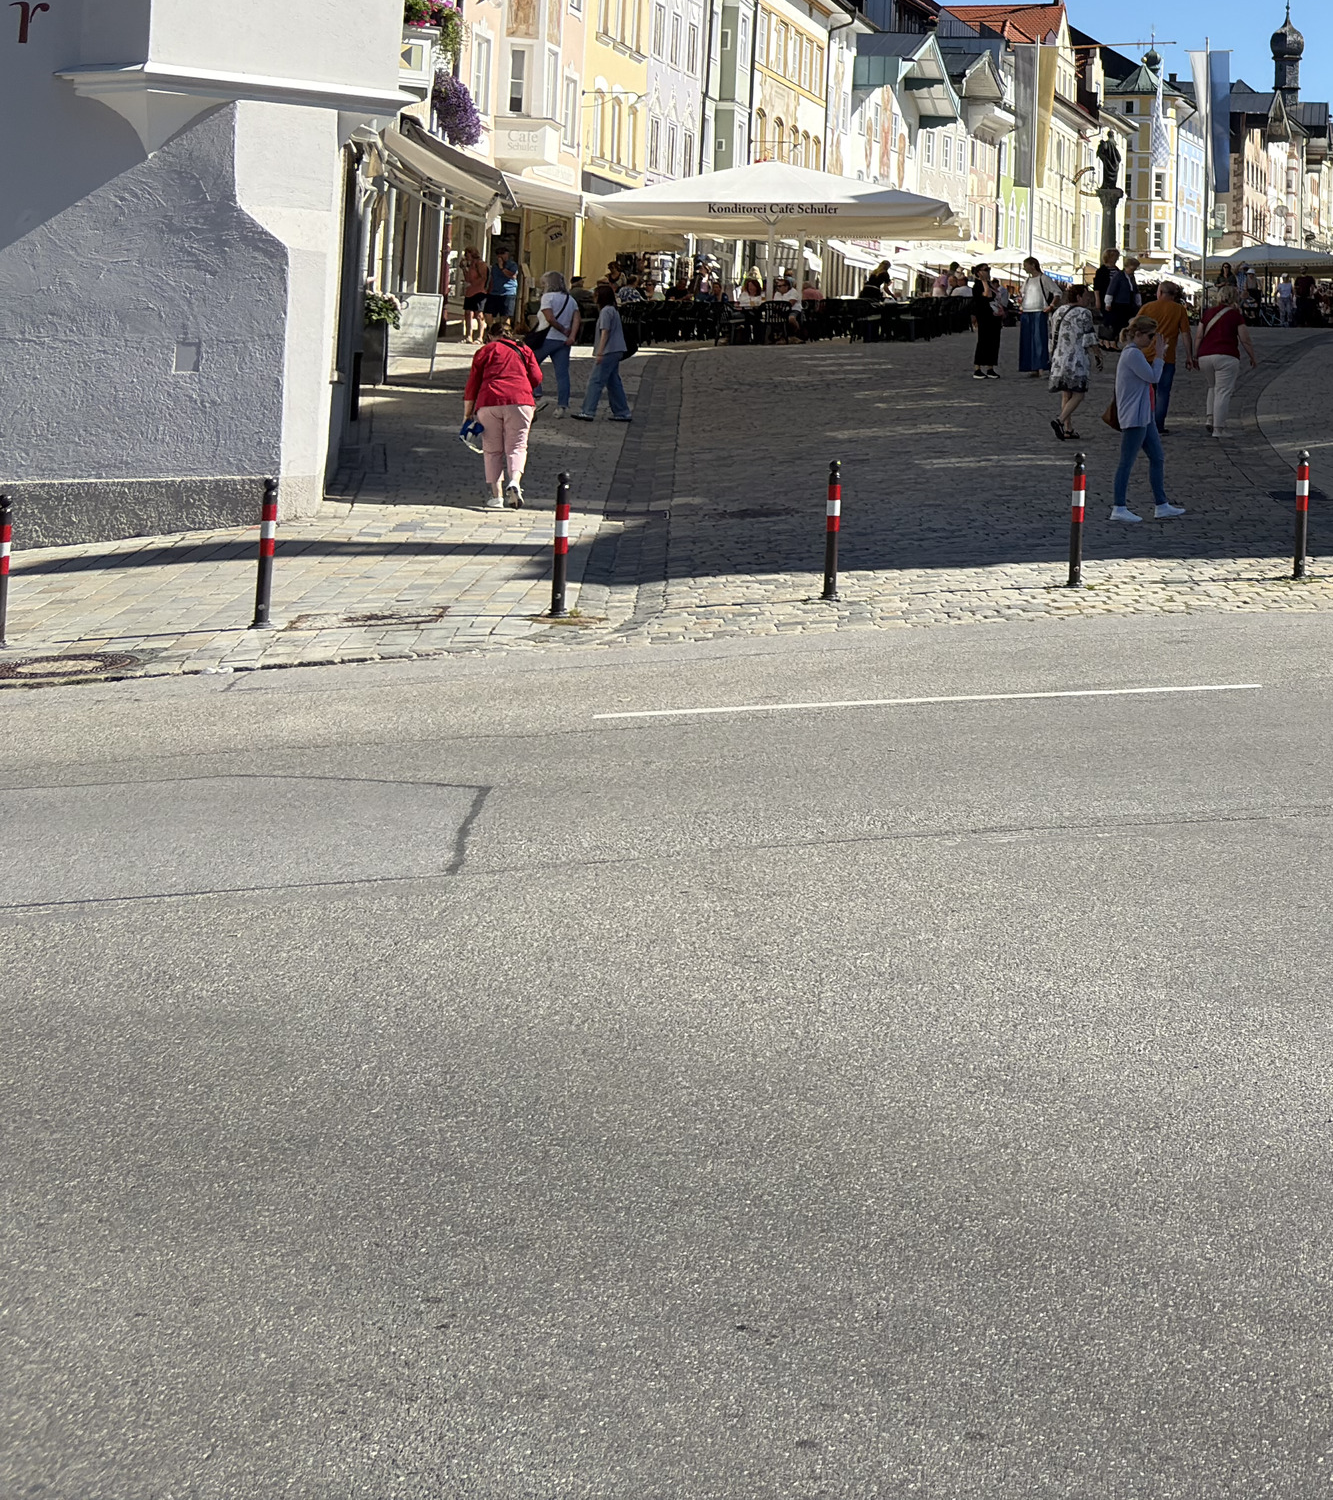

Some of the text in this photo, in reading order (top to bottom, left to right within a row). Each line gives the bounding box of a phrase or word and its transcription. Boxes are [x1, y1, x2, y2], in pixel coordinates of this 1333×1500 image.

[708, 203, 839, 215] Konditorei Café Schuler
